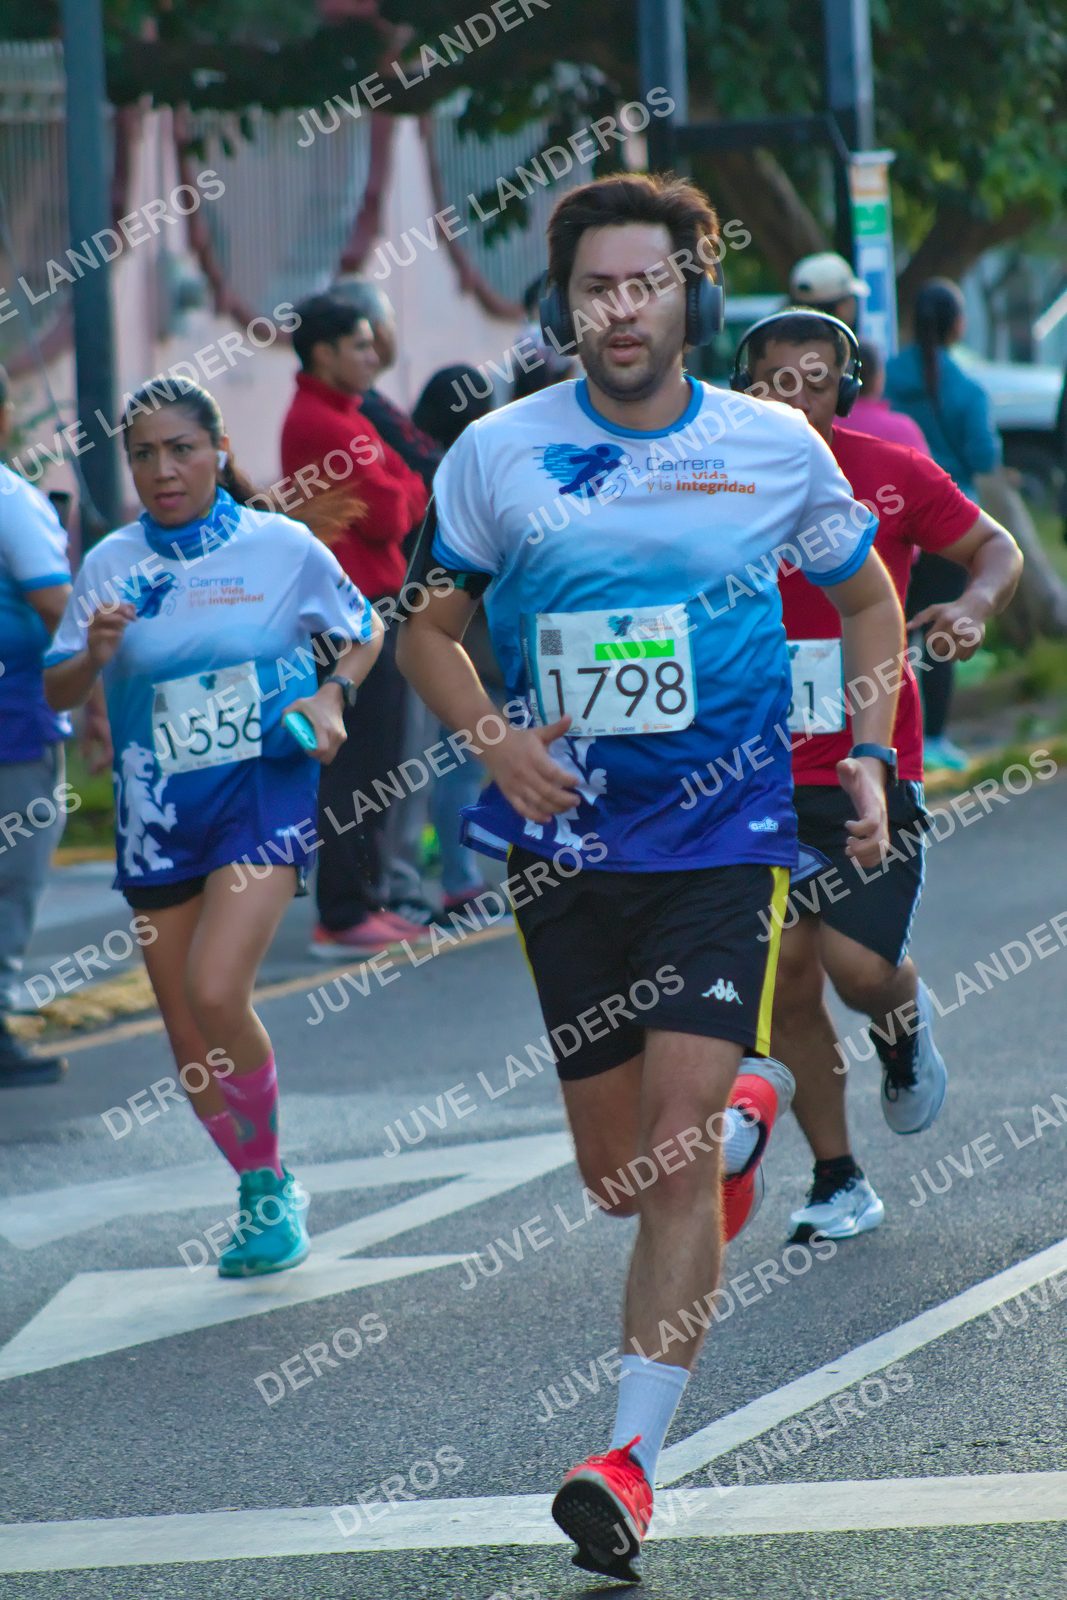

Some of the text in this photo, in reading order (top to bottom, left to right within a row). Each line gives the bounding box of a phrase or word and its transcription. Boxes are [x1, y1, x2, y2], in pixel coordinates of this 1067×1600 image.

[646, 457, 725, 471] Carrera
[659, 479, 672, 491] la
[677, 480, 756, 495] Integridad
[189, 576, 244, 588] Carrera
[548, 661, 687, 720] 1798
[159, 702, 262, 760] 1556
